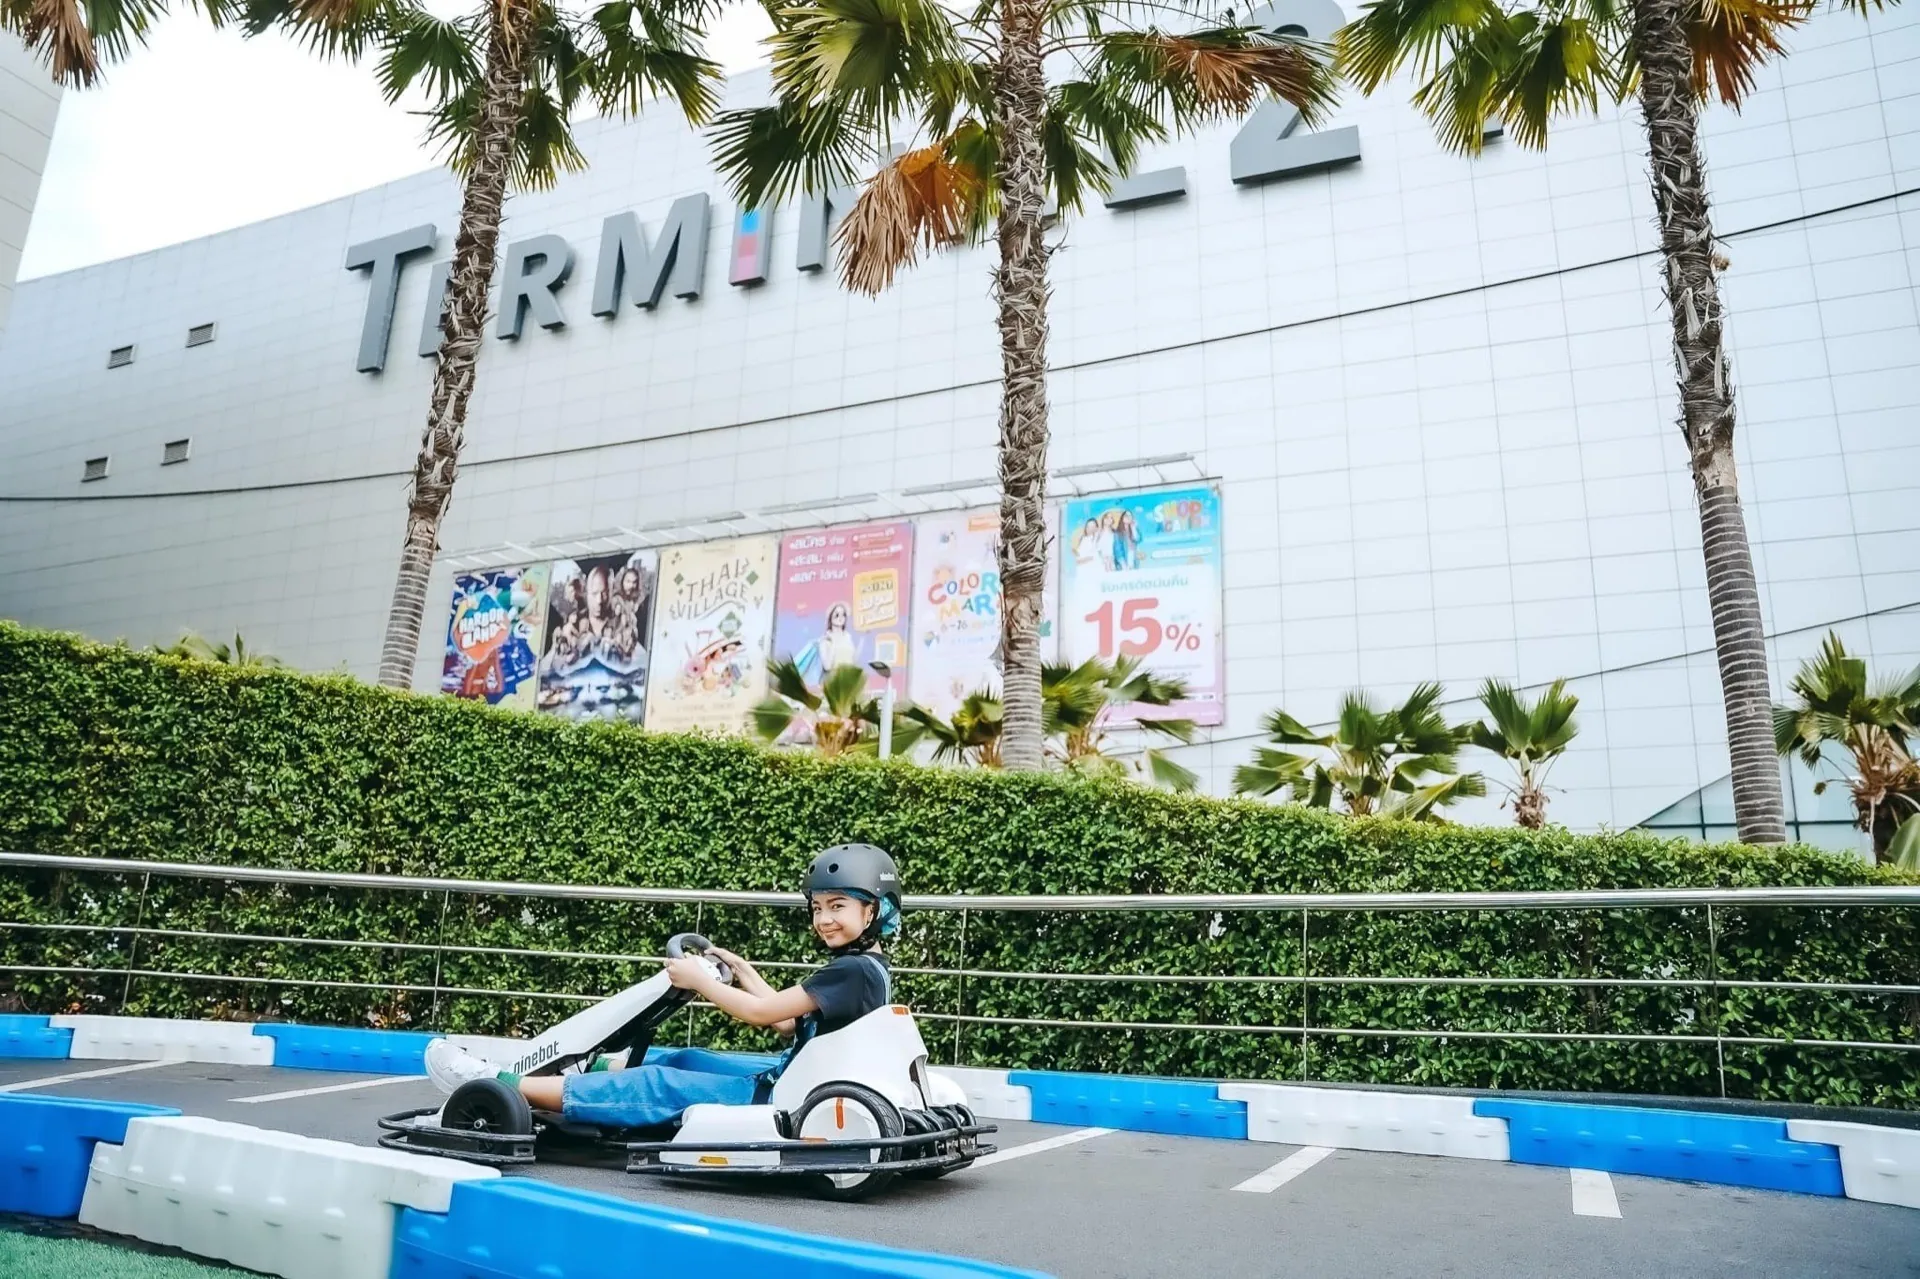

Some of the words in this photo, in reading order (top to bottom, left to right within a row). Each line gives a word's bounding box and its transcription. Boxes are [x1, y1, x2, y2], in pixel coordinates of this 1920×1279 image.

[346, 136, 1187, 373] TRMI
[675, 582, 749, 621] VILLAGE
[928, 572, 998, 605] COLOR
[939, 594, 1001, 621] MAR
[514, 1040, 560, 1075] ninebot
